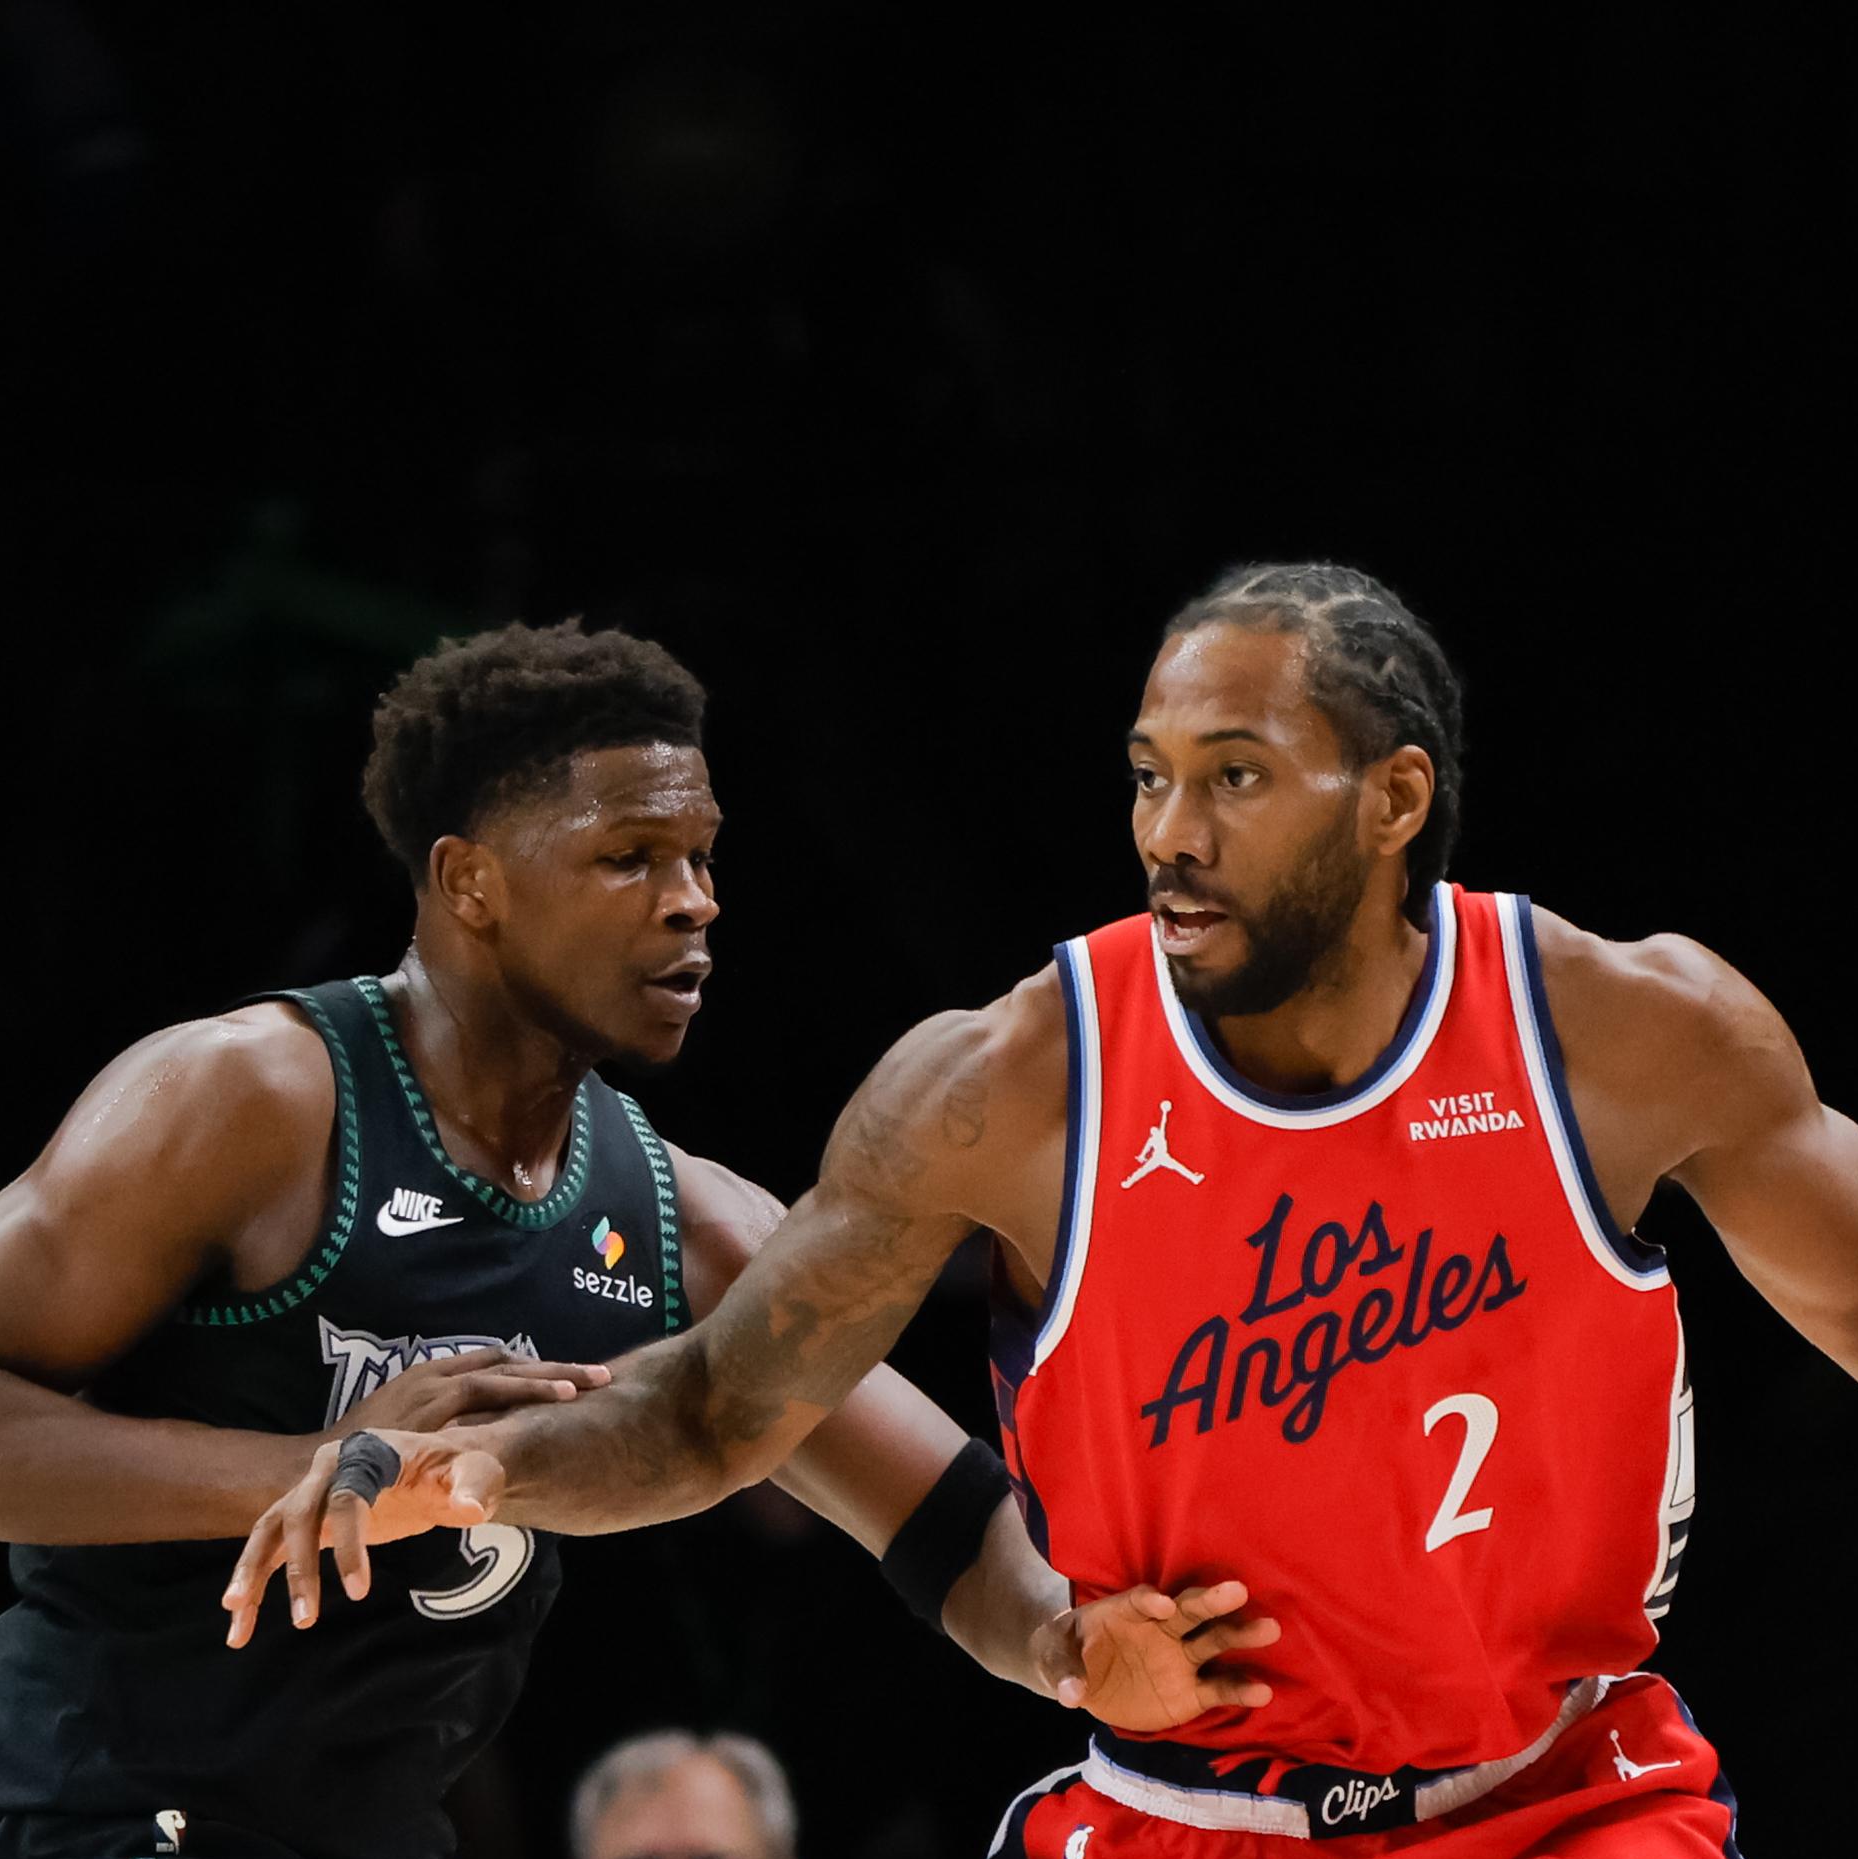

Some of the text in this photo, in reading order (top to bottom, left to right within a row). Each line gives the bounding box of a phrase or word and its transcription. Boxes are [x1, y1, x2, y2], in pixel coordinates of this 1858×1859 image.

[1408, 1109, 1526, 1141] RWANDA
[1428, 1091, 1494, 1118] VISIT
[390, 1187, 444, 1222] NIKE
[1238, 1192, 1405, 1326] Los
[573, 1266, 654, 1308] sezzle
[1140, 1228, 1529, 1450] Angeles
[1422, 1392, 1500, 1553] 2
[1322, 1776, 1401, 1825] Clips
